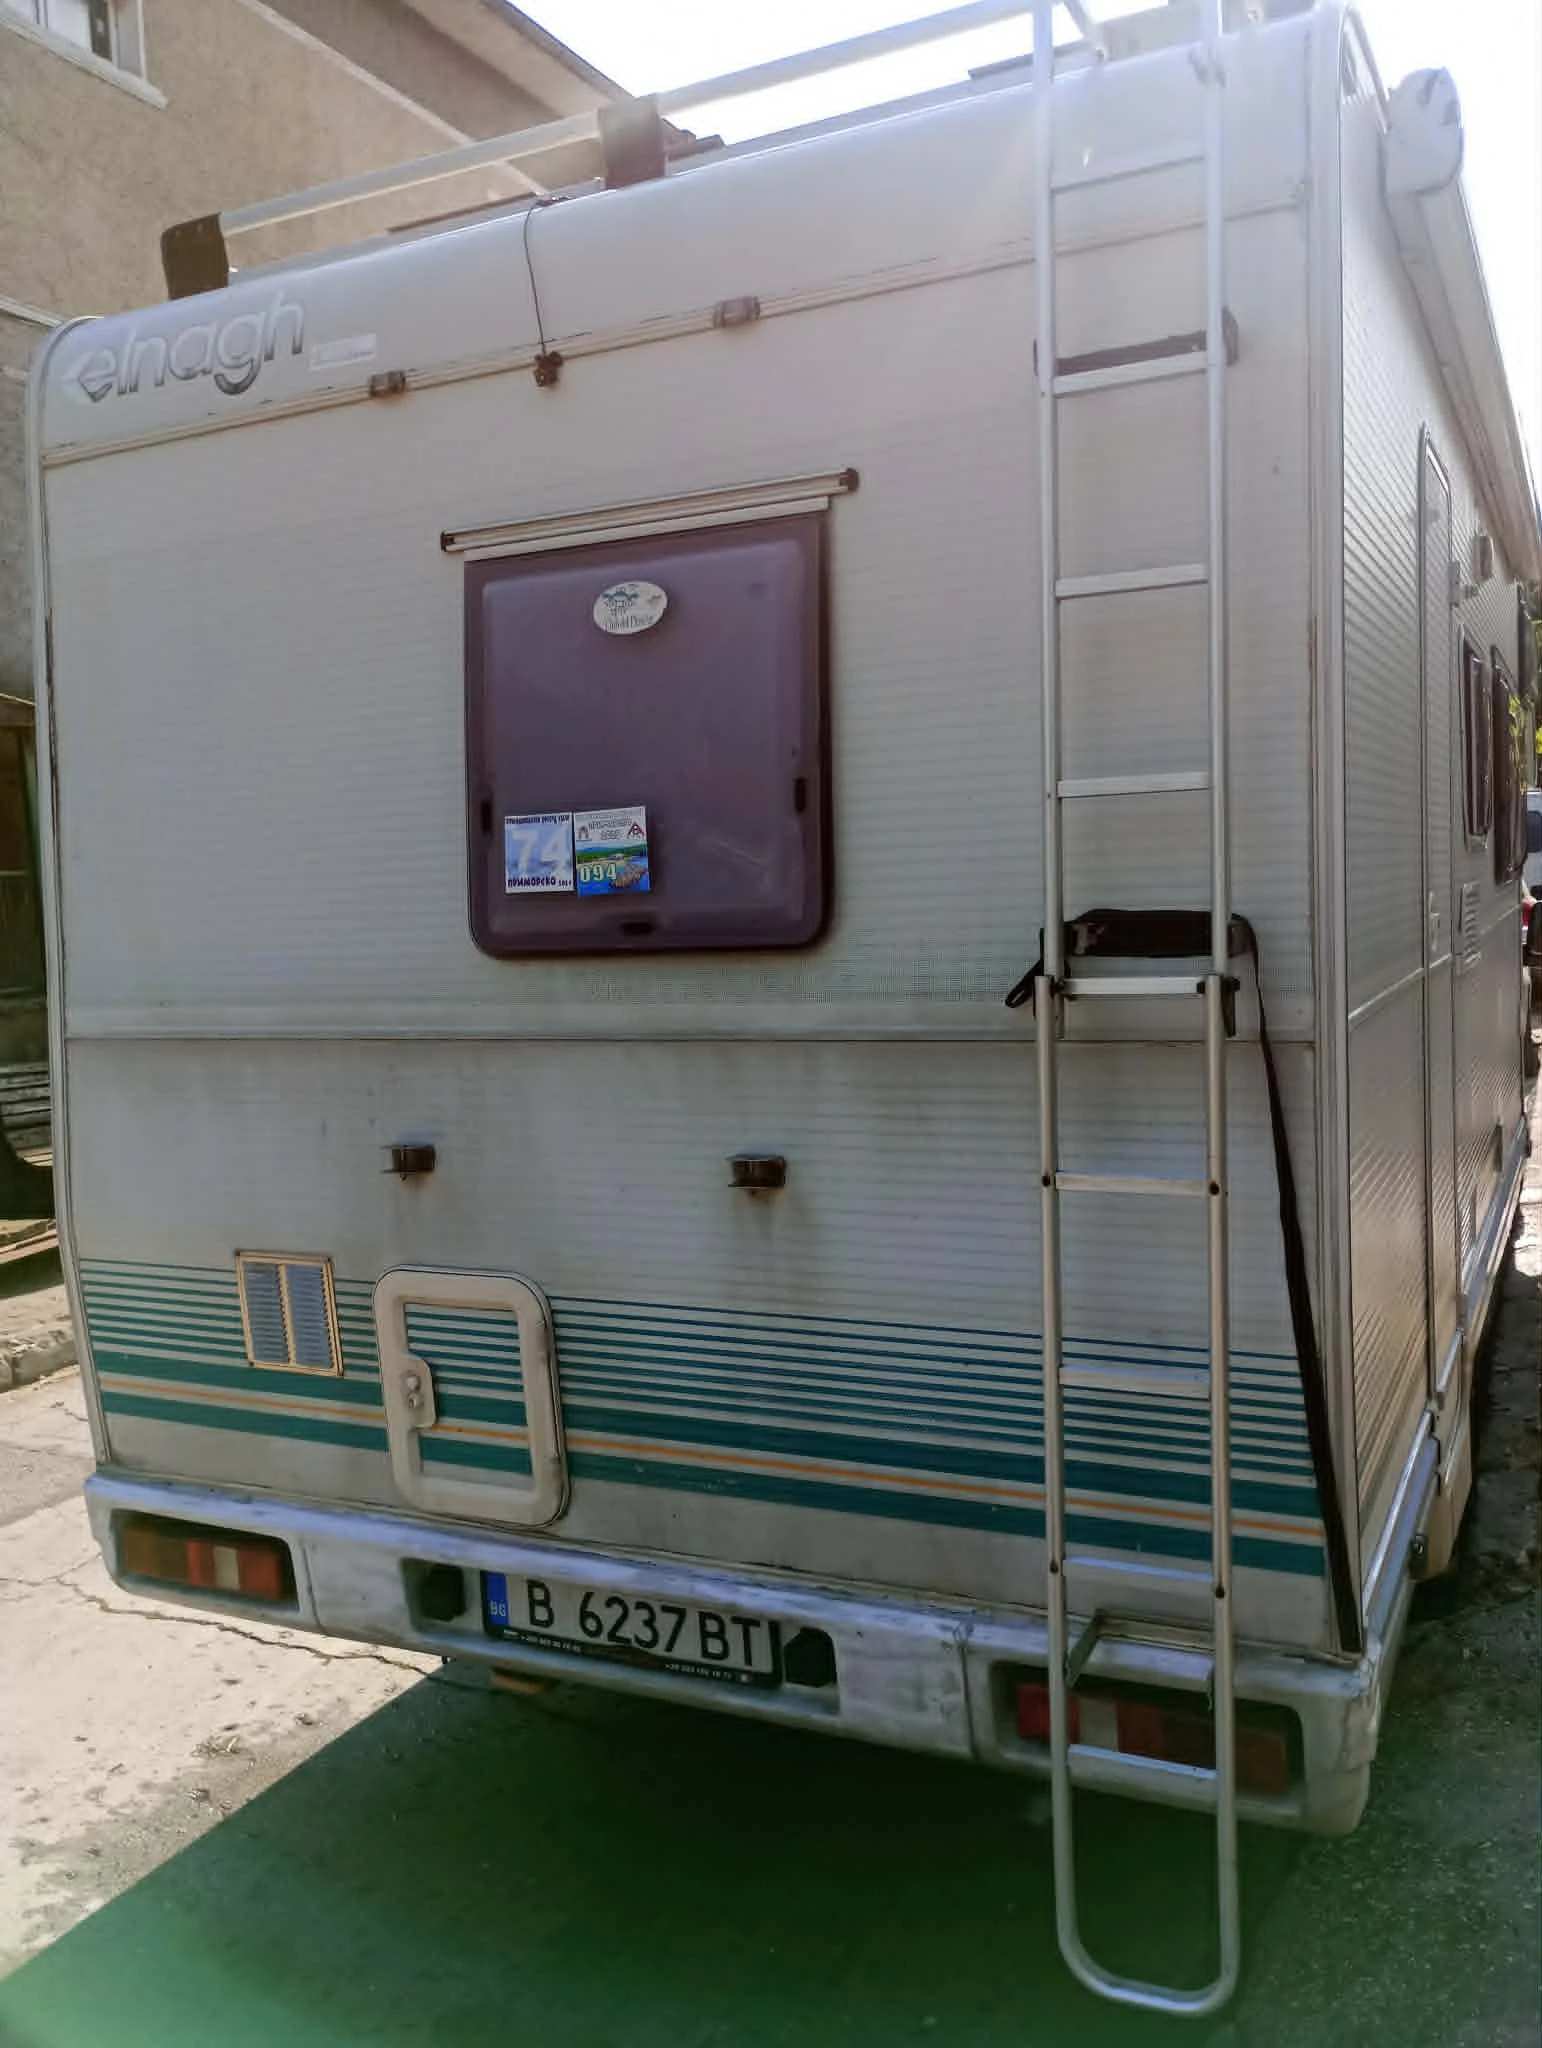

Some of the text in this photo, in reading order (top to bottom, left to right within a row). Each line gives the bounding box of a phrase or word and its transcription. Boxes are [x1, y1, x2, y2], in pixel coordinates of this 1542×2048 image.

[77, 290, 304, 403] elnagh
[511, 826, 568, 876] 74
[579, 862, 618, 883] 094
[489, 1601, 507, 1617] BG
[526, 1579, 554, 1629] B
[578, 1591, 687, 1653] 6237
